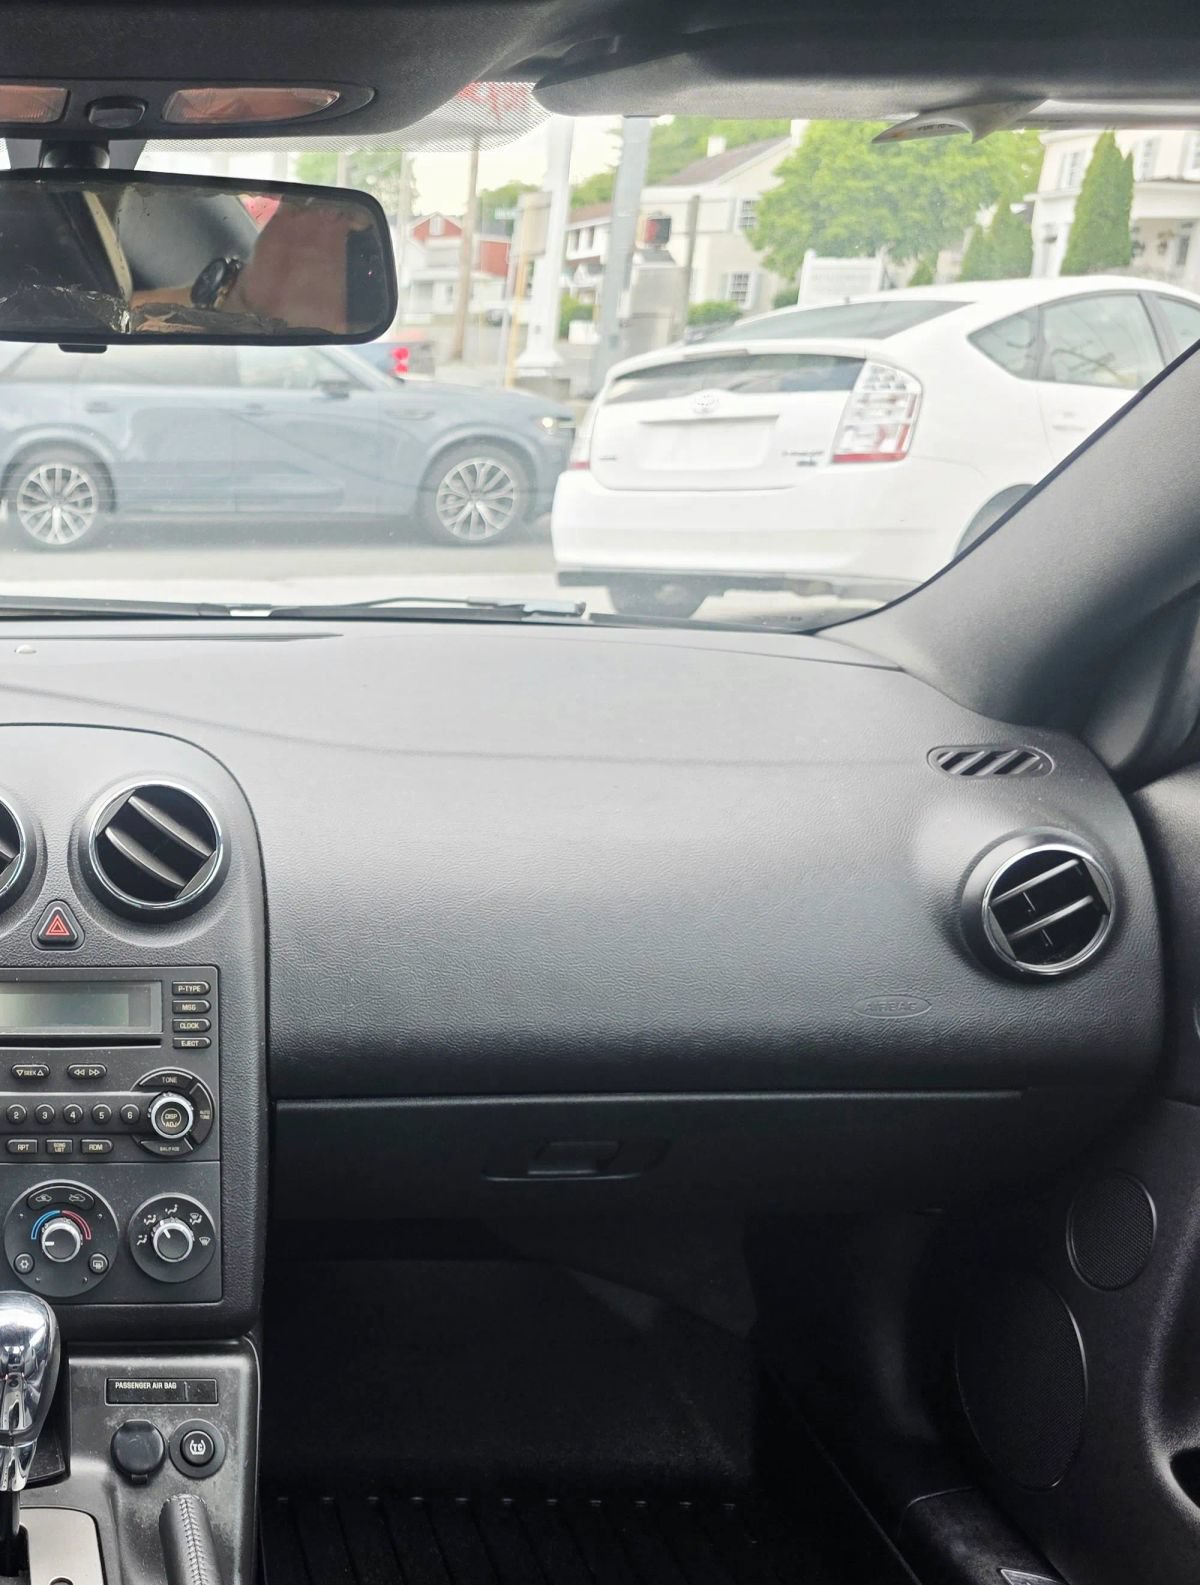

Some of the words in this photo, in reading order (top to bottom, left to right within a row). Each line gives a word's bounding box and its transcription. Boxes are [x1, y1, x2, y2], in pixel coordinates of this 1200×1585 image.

[864, 1001, 917, 1012] AIRBAG
[162, 1076, 178, 1084] TONE
[13, 1111, 19, 1119] 2
[42, 1111, 48, 1119] 3
[70, 1111, 76, 1119] 4
[99, 1111, 105, 1119] 5
[127, 1111, 133, 1119] 6
